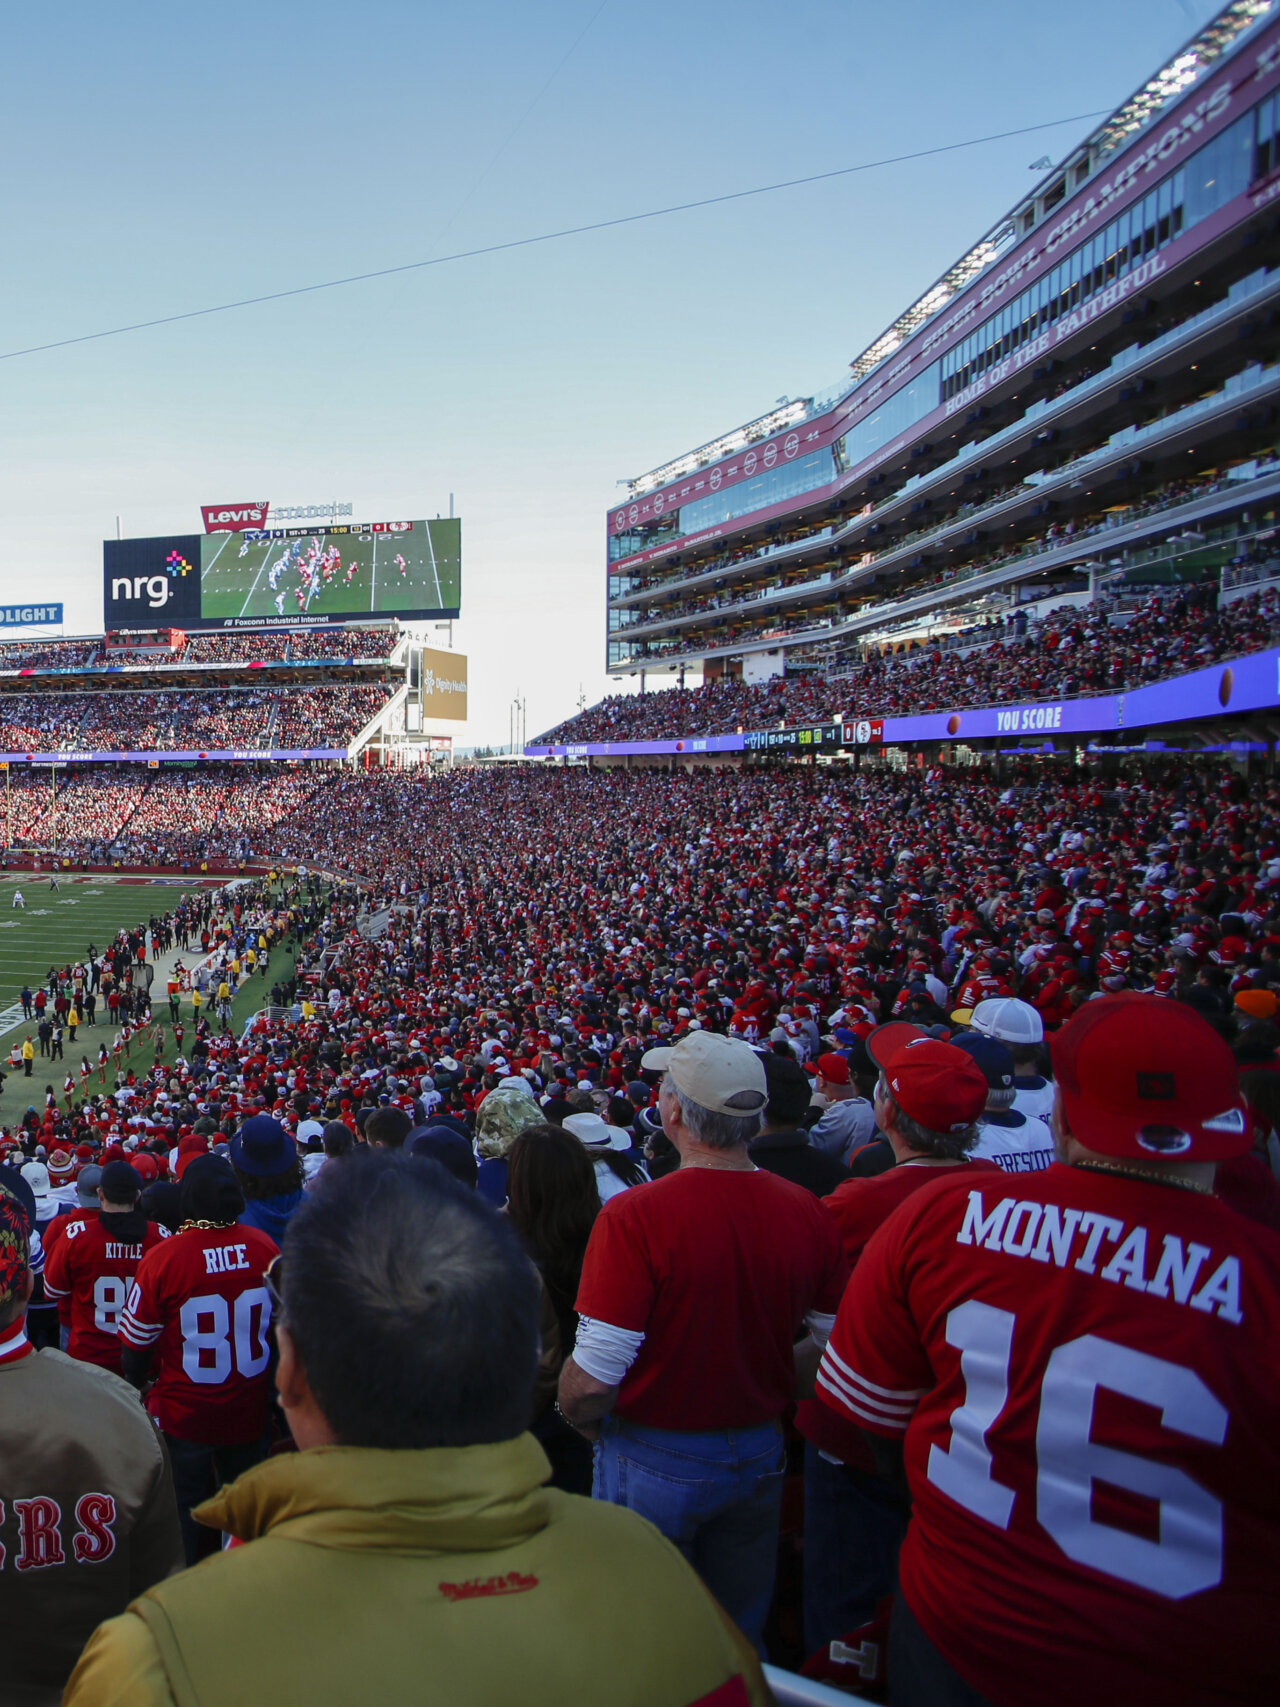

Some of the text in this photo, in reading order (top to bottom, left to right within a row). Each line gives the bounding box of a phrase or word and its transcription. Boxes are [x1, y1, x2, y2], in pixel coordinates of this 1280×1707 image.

[920, 298, 977, 358] SUPER
[981, 248, 1043, 306] BOWL
[1045, 83, 1231, 254] CHAMPIONS
[944, 255, 1166, 416] HOME OF THE FAITHFUL
[275, 503, 353, 519] STADIUM
[234, 618, 264, 626] Foxconn
[266, 617, 298, 625] Industrial
[300, 615, 329, 624] Internet
[436, 678, 467, 693] Dignity Health
[997, 706, 1062, 731] YOU SCORE
[798, 730, 812, 744] 15:00
[992, 1148, 1055, 1174] PRESCOT
[105, 1242, 143, 1260] KITTLE
[202, 1243, 251, 1275] RICE
[956, 1190, 1244, 1325] MONTANA
[93, 1276, 135, 1335] 8
[179, 1286, 274, 1385] 80
[927, 1299, 1229, 1601] 16
[438, 1576, 496, 1601] Mitchell
